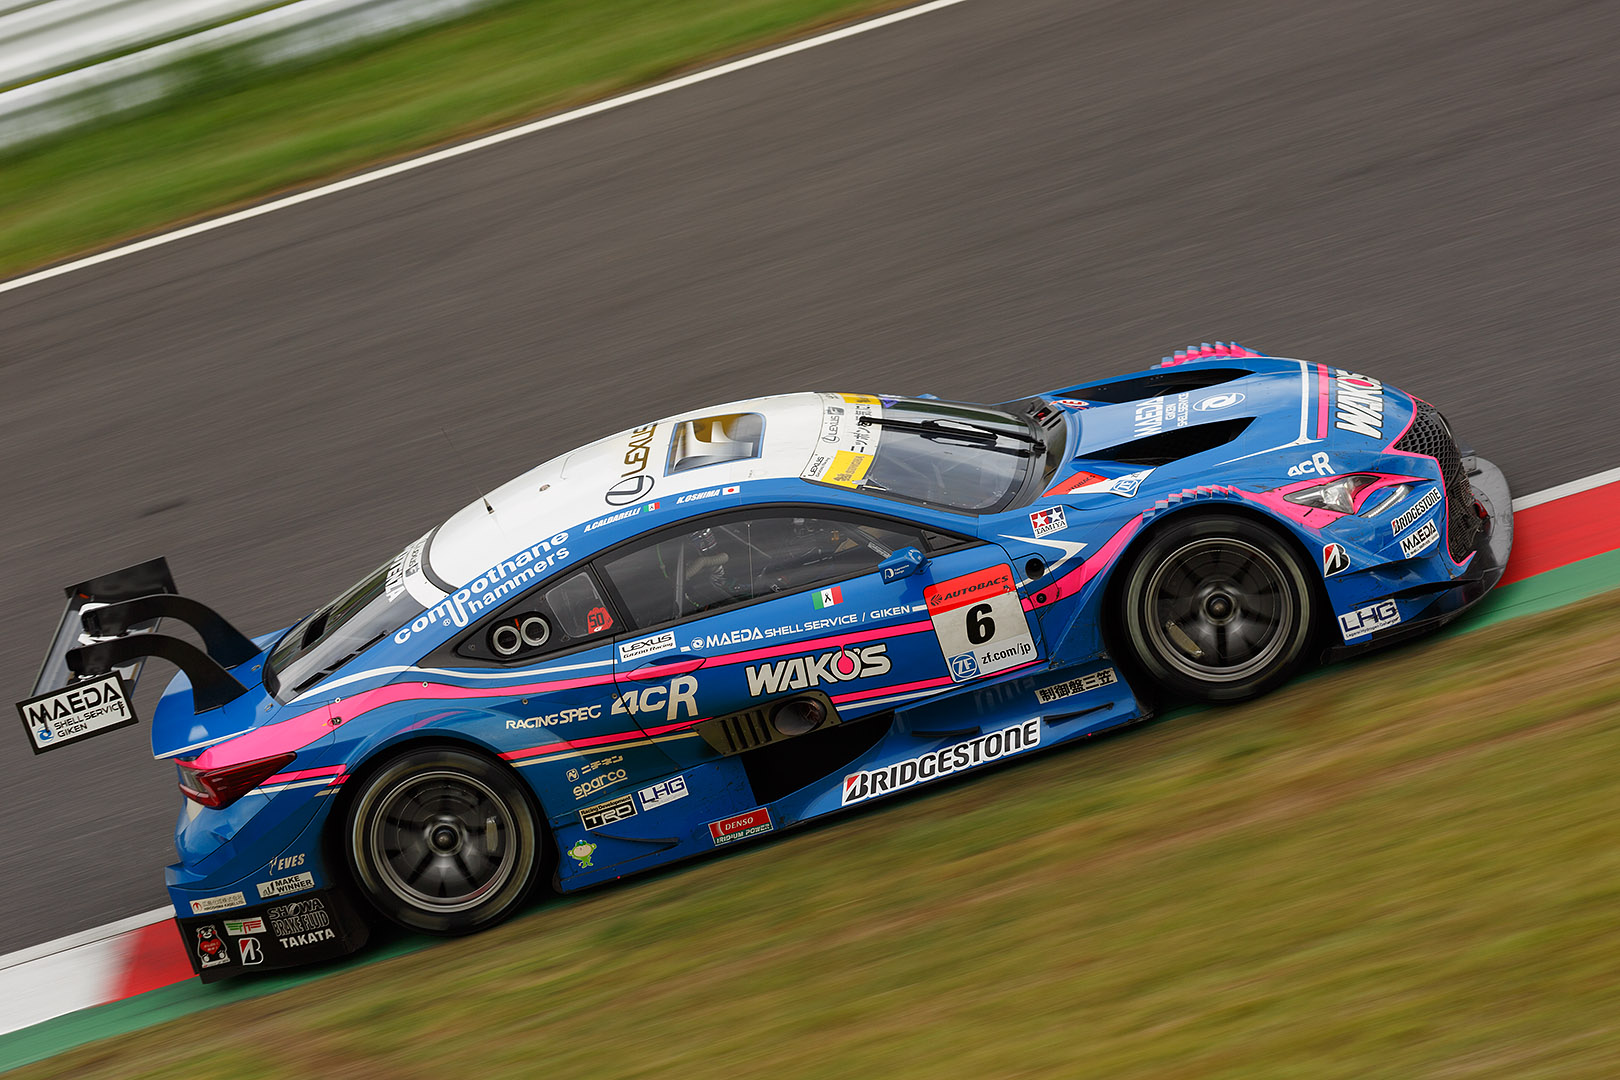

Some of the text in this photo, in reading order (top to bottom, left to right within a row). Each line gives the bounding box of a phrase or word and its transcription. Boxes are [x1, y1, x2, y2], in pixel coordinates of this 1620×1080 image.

[1134, 396, 1164, 438] MAEDA
[808, 456, 825, 477] LEXUS
[676, 489, 721, 505] K.OSHIMA
[583, 507, 641, 533] A.CALDARELLI
[1392, 488, 1441, 535] BRIDGESTONE
[1035, 520, 1066, 535] TAMIYA
[1402, 522, 1437, 553] MAEDA
[469, 547, 570, 615] hammers
[943, 575, 1009, 601] AUTOBACS
[588, 612, 606, 628] 50
[706, 627, 764, 649] MAEDA
[870, 605, 911, 619] GIKEN
[965, 603, 996, 645] 6
[1341, 601, 1398, 632] LHG
[621, 634, 673, 654] LEXUS
[649, 641, 674, 655] Racing
[745, 643, 892, 697] WAKO'S
[953, 642, 1031, 675] ZF zf.com/jp
[1039, 670, 1115, 702] 制御盤三笠
[28, 682, 122, 727] MAEDA
[506, 675, 700, 730] RACING SPEC 4CR
[57, 723, 88, 738] GIKEN
[580, 755, 624, 775] ニチネン
[844, 720, 1038, 803] BRIDGESTONE
[572, 769, 627, 798] sparco
[640, 777, 685, 804] LHG
[580, 796, 632, 816] Racing Development
[585, 804, 632, 825] TRD
[716, 823, 770, 844] IRIDIUM POWER
[725, 816, 754, 831] DENSO
[275, 875, 301, 887] MAKE
[276, 879, 313, 893] WINNER
[267, 897, 325, 920] SHOWA
[271, 909, 330, 937] BRAKE FLUID
[279, 928, 336, 949] TAKATA
